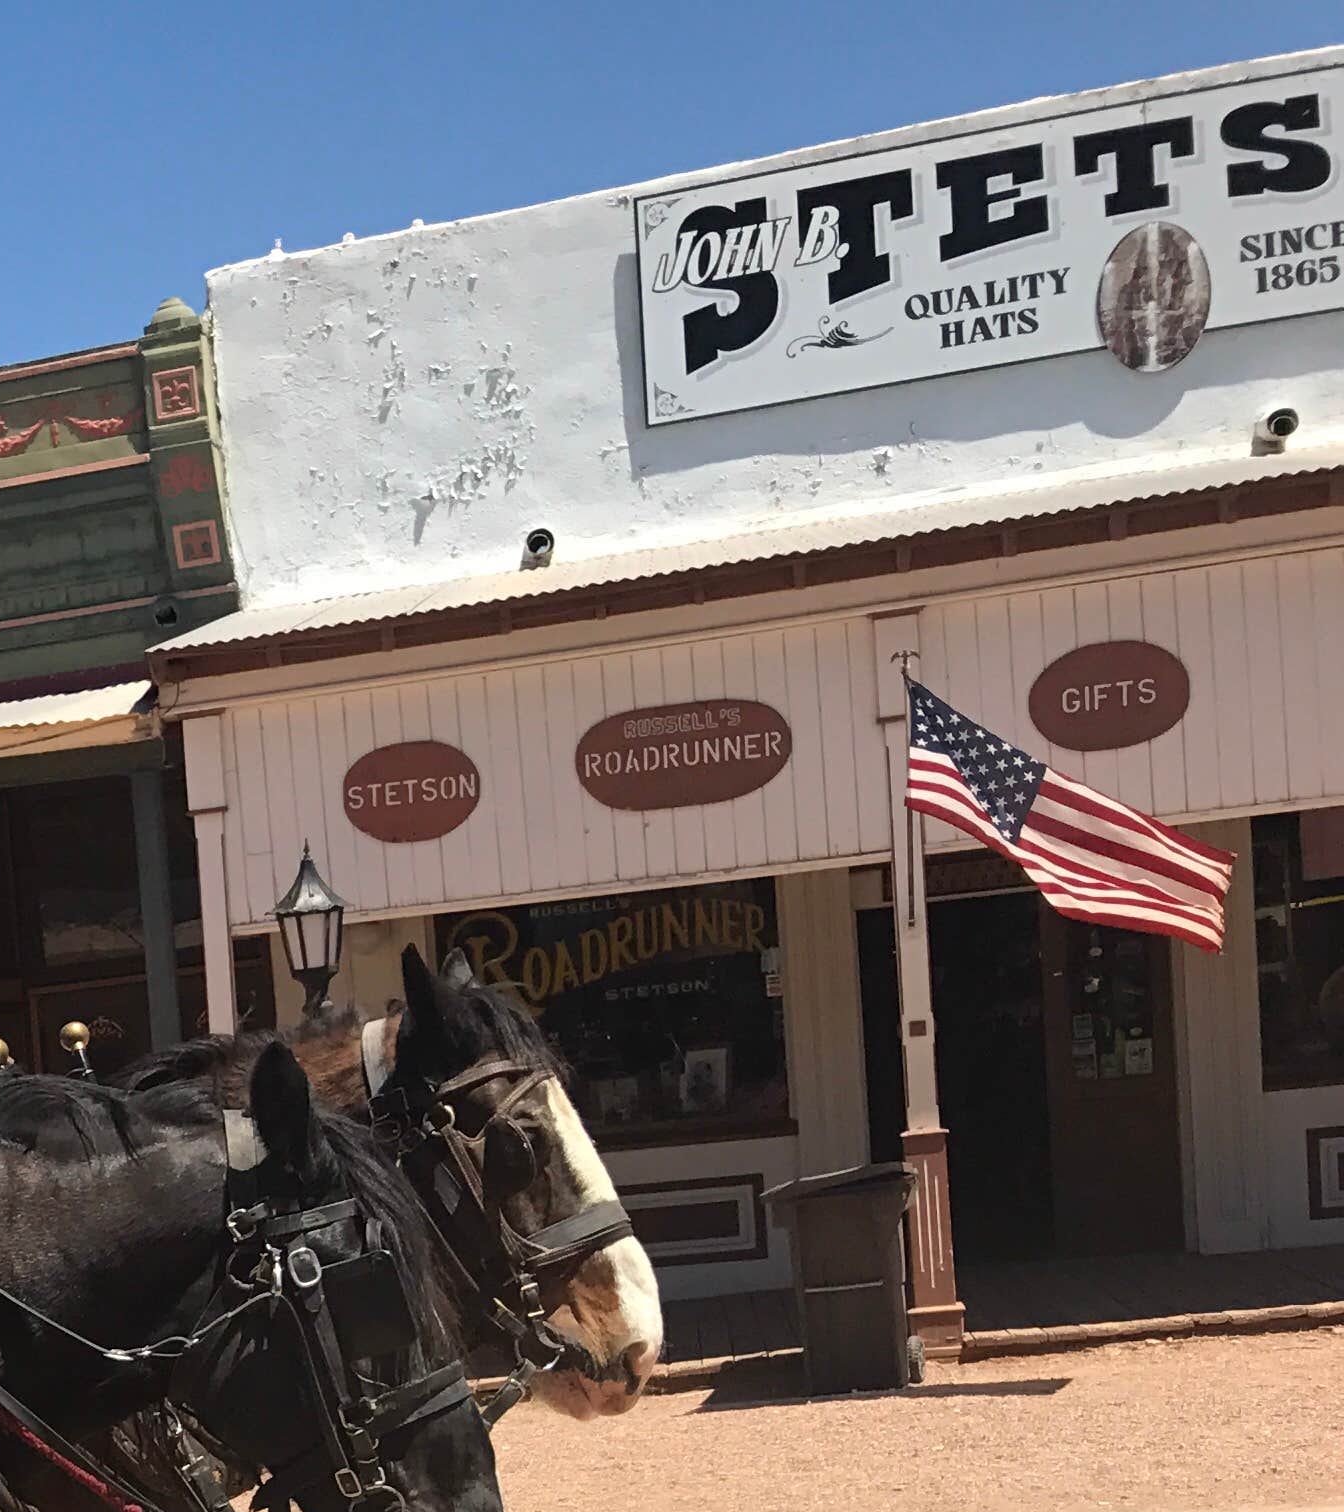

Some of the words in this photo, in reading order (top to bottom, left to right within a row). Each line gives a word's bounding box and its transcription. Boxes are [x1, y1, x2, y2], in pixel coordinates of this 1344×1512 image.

[652, 216, 792, 293] JOHN
[794, 205, 850, 267] B.
[676, 93, 1332, 375] STETS
[1240, 220, 1344, 263] SINCE
[904, 267, 1071, 320] QUALITY
[1254, 255, 1341, 294] 1865
[939, 307, 1040, 350] HATS
[1061, 678, 1157, 714] GIFTS
[623, 707, 742, 740] RUSSELL'S
[583, 731, 783, 779] ROADRUNNER
[347, 773, 476, 810] STETSON
[449, 898, 768, 1016] ROADRUNNER
[604, 978, 710, 1002] STETSON
